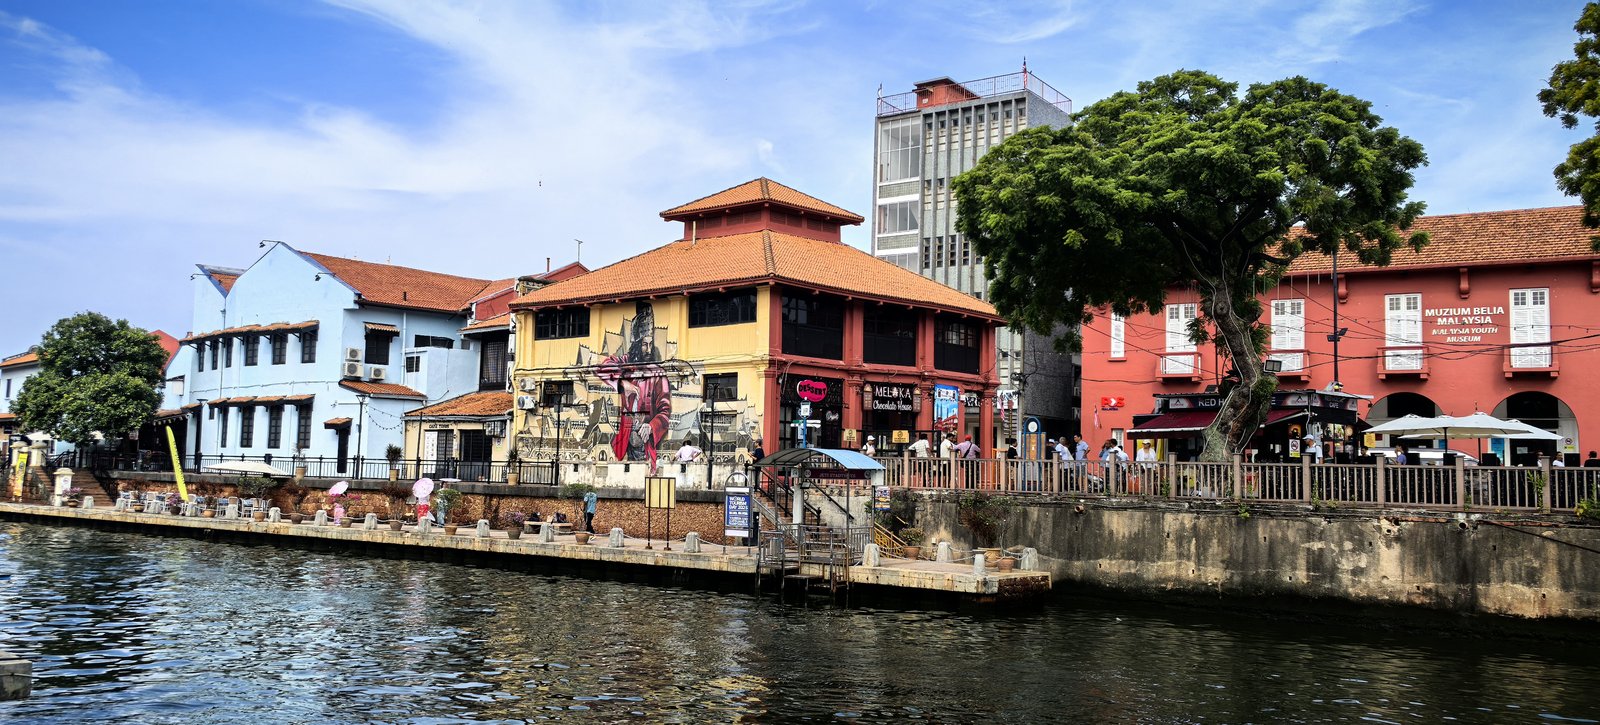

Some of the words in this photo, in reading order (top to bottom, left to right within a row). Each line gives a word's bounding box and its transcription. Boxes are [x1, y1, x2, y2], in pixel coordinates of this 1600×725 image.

[1425, 308, 1471, 316] MUZIUM
[1473, 306, 1504, 314] BELIA
[1437, 316, 1492, 325] MALAYSIA
[1432, 328, 1470, 336] MALAYSIA
[799, 384, 827, 395] DESSERT
[873, 400, 897, 410] Chocolate
[897, 400, 913, 411] House
[1101, 397, 1125, 407] POS
[1198, 398, 1217, 407] RED
